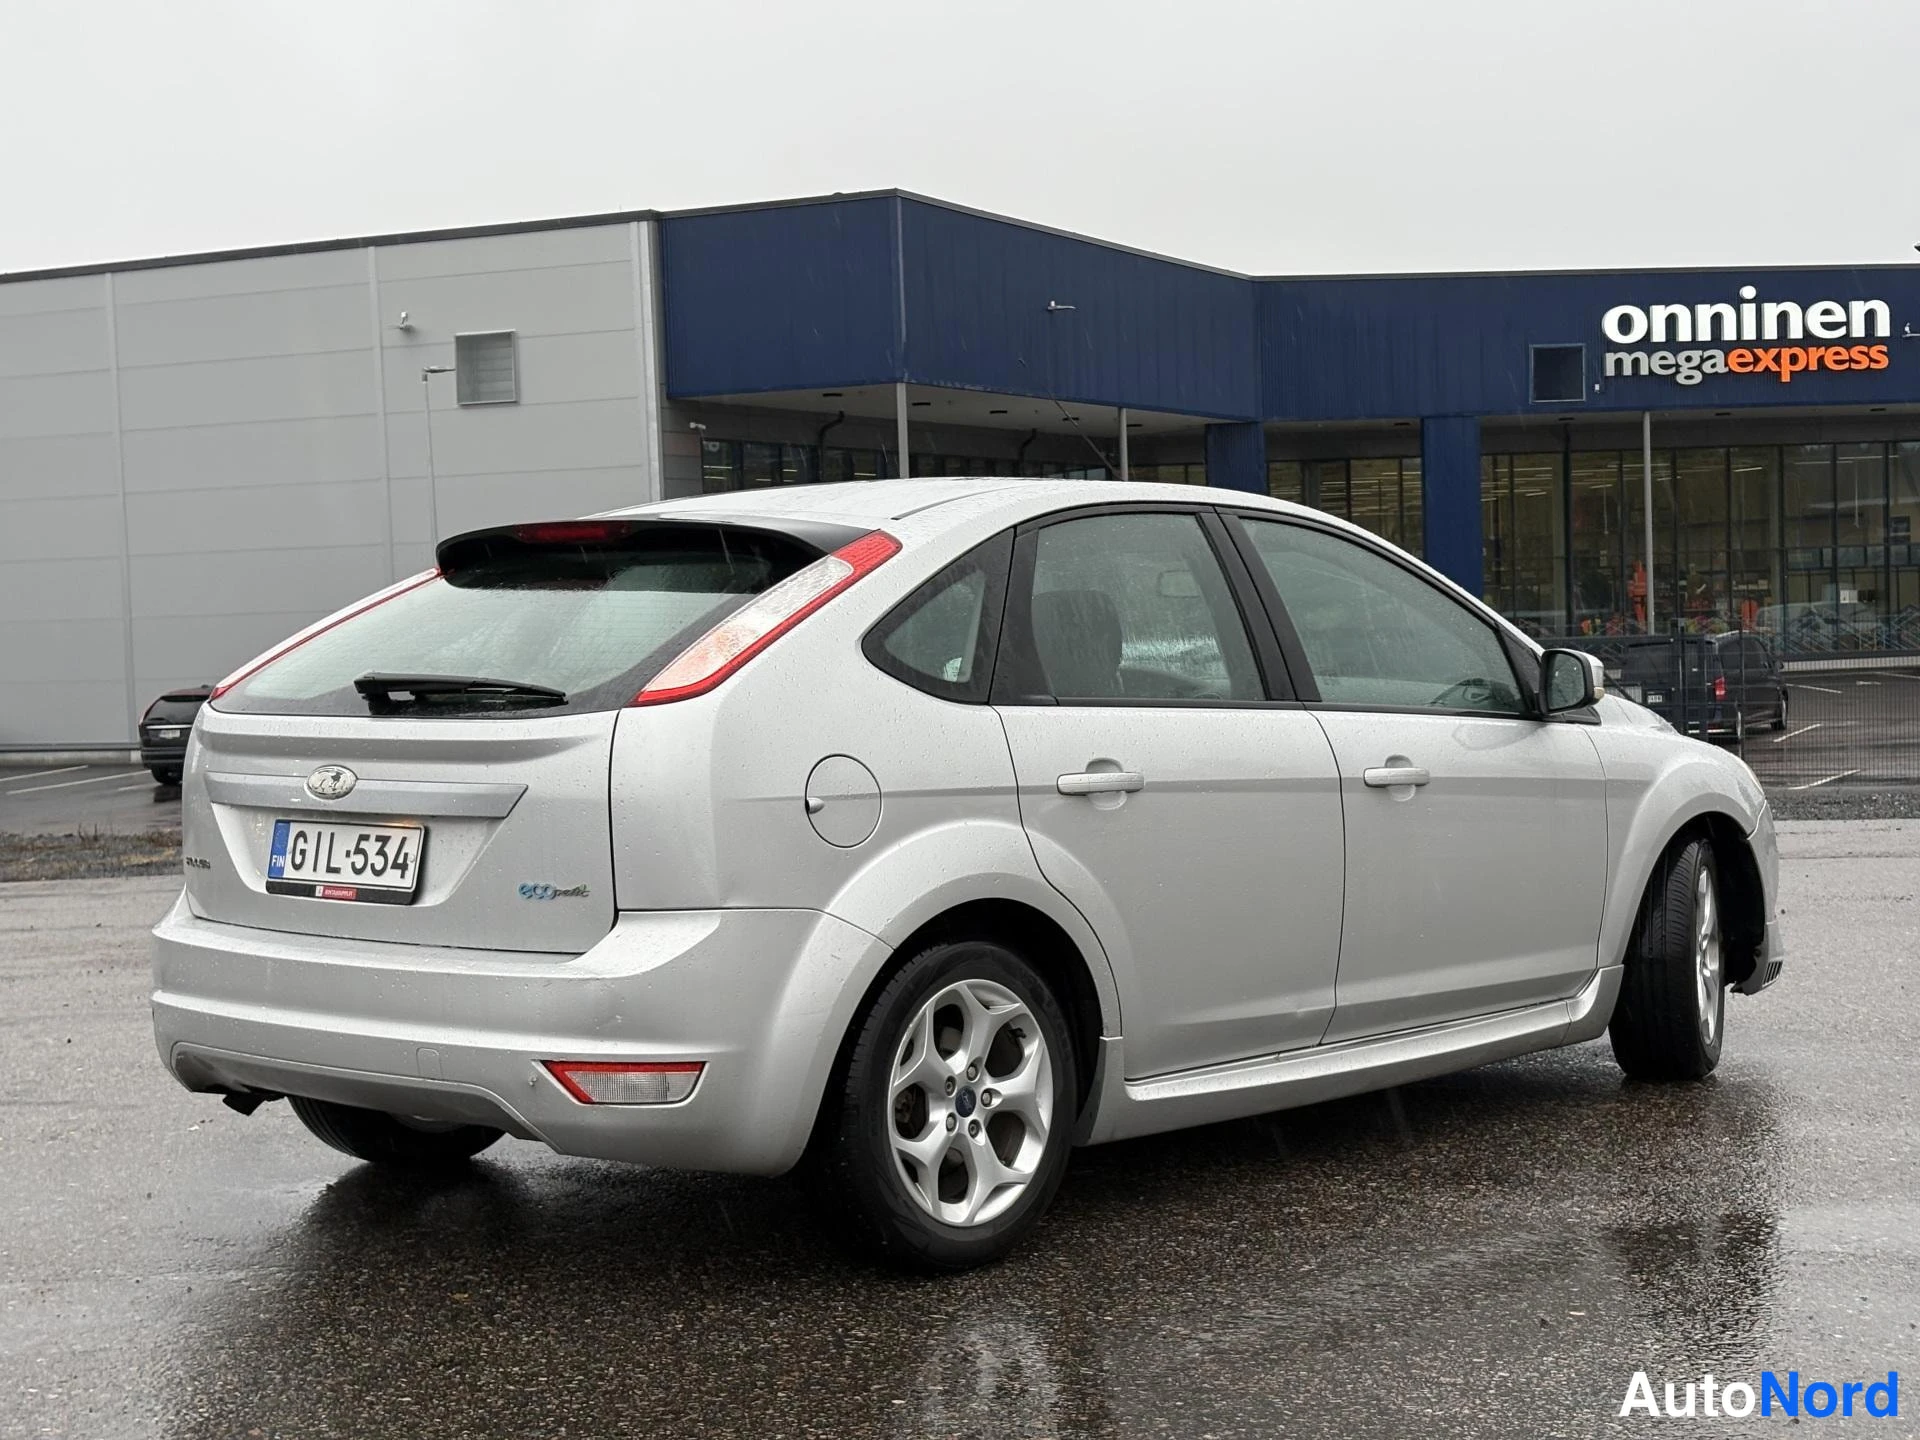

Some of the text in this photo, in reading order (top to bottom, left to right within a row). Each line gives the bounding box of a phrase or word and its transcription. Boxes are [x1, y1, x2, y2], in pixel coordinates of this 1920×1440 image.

[1602, 285, 1891, 344] onninen
[1605, 344, 1889, 386] megaexpress
[271, 855, 285, 867] FIN
[291, 830, 409, 879] GIL-534
